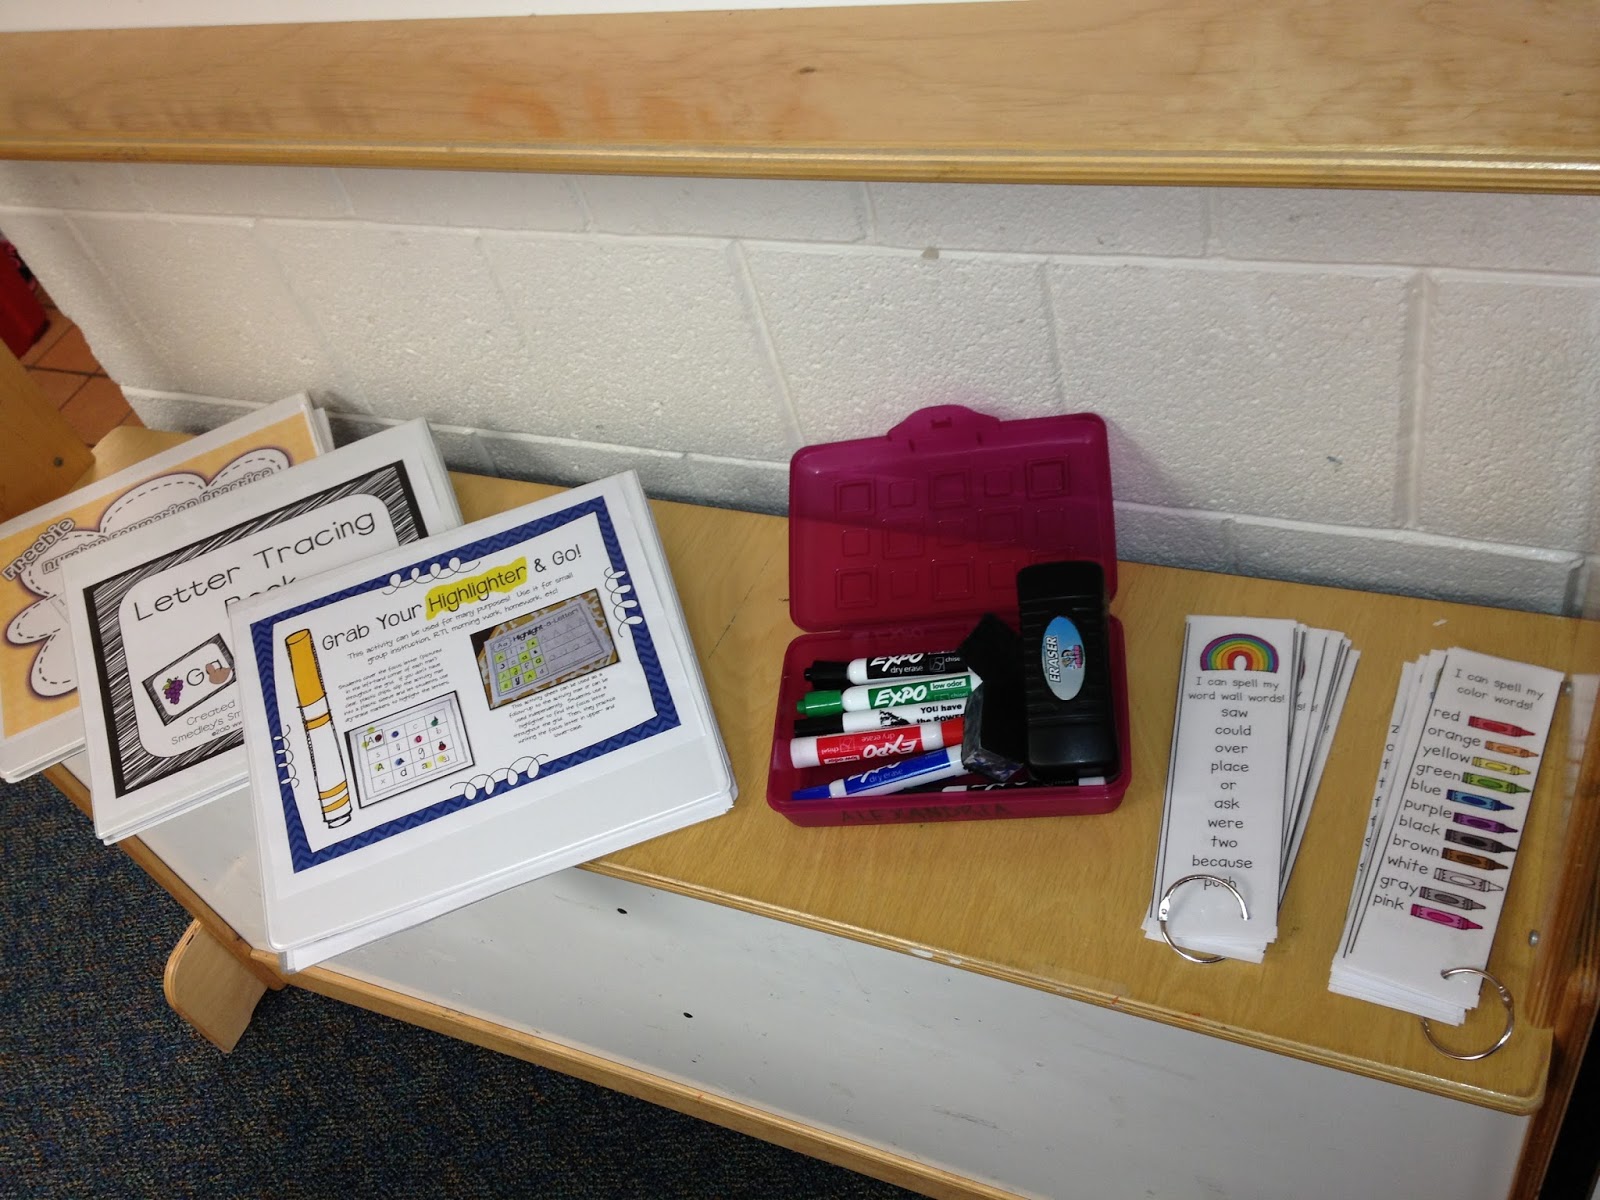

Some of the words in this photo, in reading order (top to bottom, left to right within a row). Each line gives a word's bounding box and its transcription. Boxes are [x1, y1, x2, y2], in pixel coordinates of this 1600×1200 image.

[134, 566, 241, 621] Letter
[253, 512, 376, 568] Tracing
[322, 624, 370, 650] Grab
[376, 604, 422, 629] Your
[429, 565, 526, 612] Highlighter
[534, 558, 546, 572] &
[552, 544, 582, 566] Go!
[347, 651, 364, 659] This
[366, 640, 394, 653] activity
[396, 634, 409, 643] can
[411, 629, 420, 637] be
[422, 622, 439, 632] used
[442, 618, 452, 626] for
[456, 610, 474, 619] many
[516, 588, 531, 597] Use
[541, 580, 552, 589] for
[556, 572, 573, 584] small
[368, 651, 388, 665] group
[452, 618, 480, 631] morning
[870, 653, 924, 672] EXPO
[1046, 636, 1061, 682] ERASER
[947, 680, 963, 688] odor
[1196, 676, 1202, 686] I
[1232, 679, 1258, 689] spell
[1263, 681, 1279, 691] my
[1455, 668, 1462, 679] I
[1467, 673, 1489, 685] can
[1494, 679, 1522, 693] spell
[1526, 688, 1544, 701] my
[874, 685, 927, 707] EXPO
[1188, 691, 1215, 700] word
[1221, 692, 1243, 701] wall
[1248, 694, 1285, 703] words!
[1457, 685, 1488, 699] color
[1494, 695, 1534, 711] words!
[186, 700, 235, 726] Created
[920, 705, 938, 714] YOU
[941, 703, 962, 711] have
[1221, 708, 1248, 718] saw
[1433, 708, 1461, 722] red
[171, 719, 224, 745] Smedley's
[1215, 725, 1252, 736] could
[1428, 727, 1481, 749] orange
[863, 734, 917, 759] EXPO
[1215, 744, 1248, 754] over
[1423, 746, 1470, 764] yellow
[1211, 760, 1249, 774] place
[1416, 764, 1461, 781] green
[1220, 782, 1237, 790] or
[1410, 778, 1442, 796] blue
[1214, 797, 1240, 810] ask
[1403, 799, 1453, 819] purple
[1208, 819, 1244, 829] were
[1399, 815, 1440, 836] black
[1211, 835, 1238, 848] two
[1392, 834, 1440, 857] brown
[1192, 854, 1253, 869] because
[1387, 856, 1429, 875] white
[1380, 876, 1419, 897] gray
[1372, 894, 1404, 910] pink
